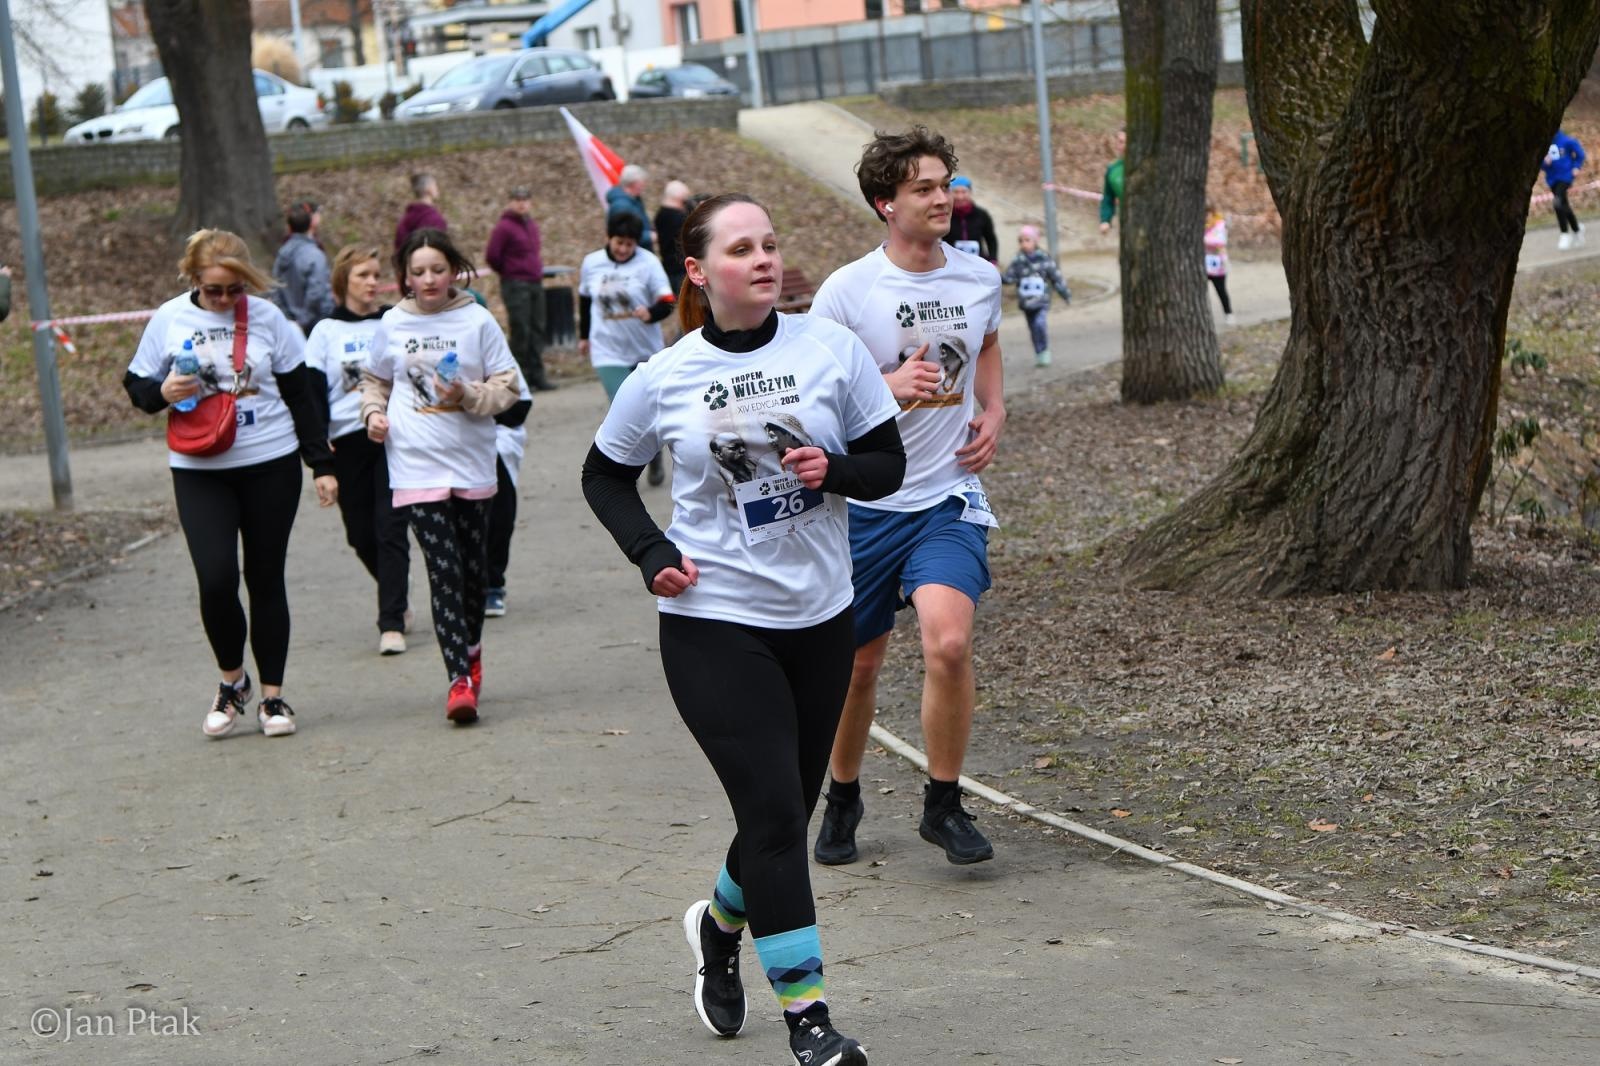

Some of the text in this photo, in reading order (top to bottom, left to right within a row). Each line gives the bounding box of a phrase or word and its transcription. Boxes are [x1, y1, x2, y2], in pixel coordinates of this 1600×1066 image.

[916, 300, 941, 309] TROPEM
[918, 305, 966, 321] WILCZYM
[953, 322, 968, 330] 2026
[422, 340, 456, 350] WILCZYM
[731, 371, 763, 384] TROPEM
[733, 374, 797, 399] WILCZYM
[737, 404, 751, 415] XIV
[752, 399, 781, 412] EDYCJA
[780, 394, 800, 406] 2026
[771, 490, 805, 520] 26
